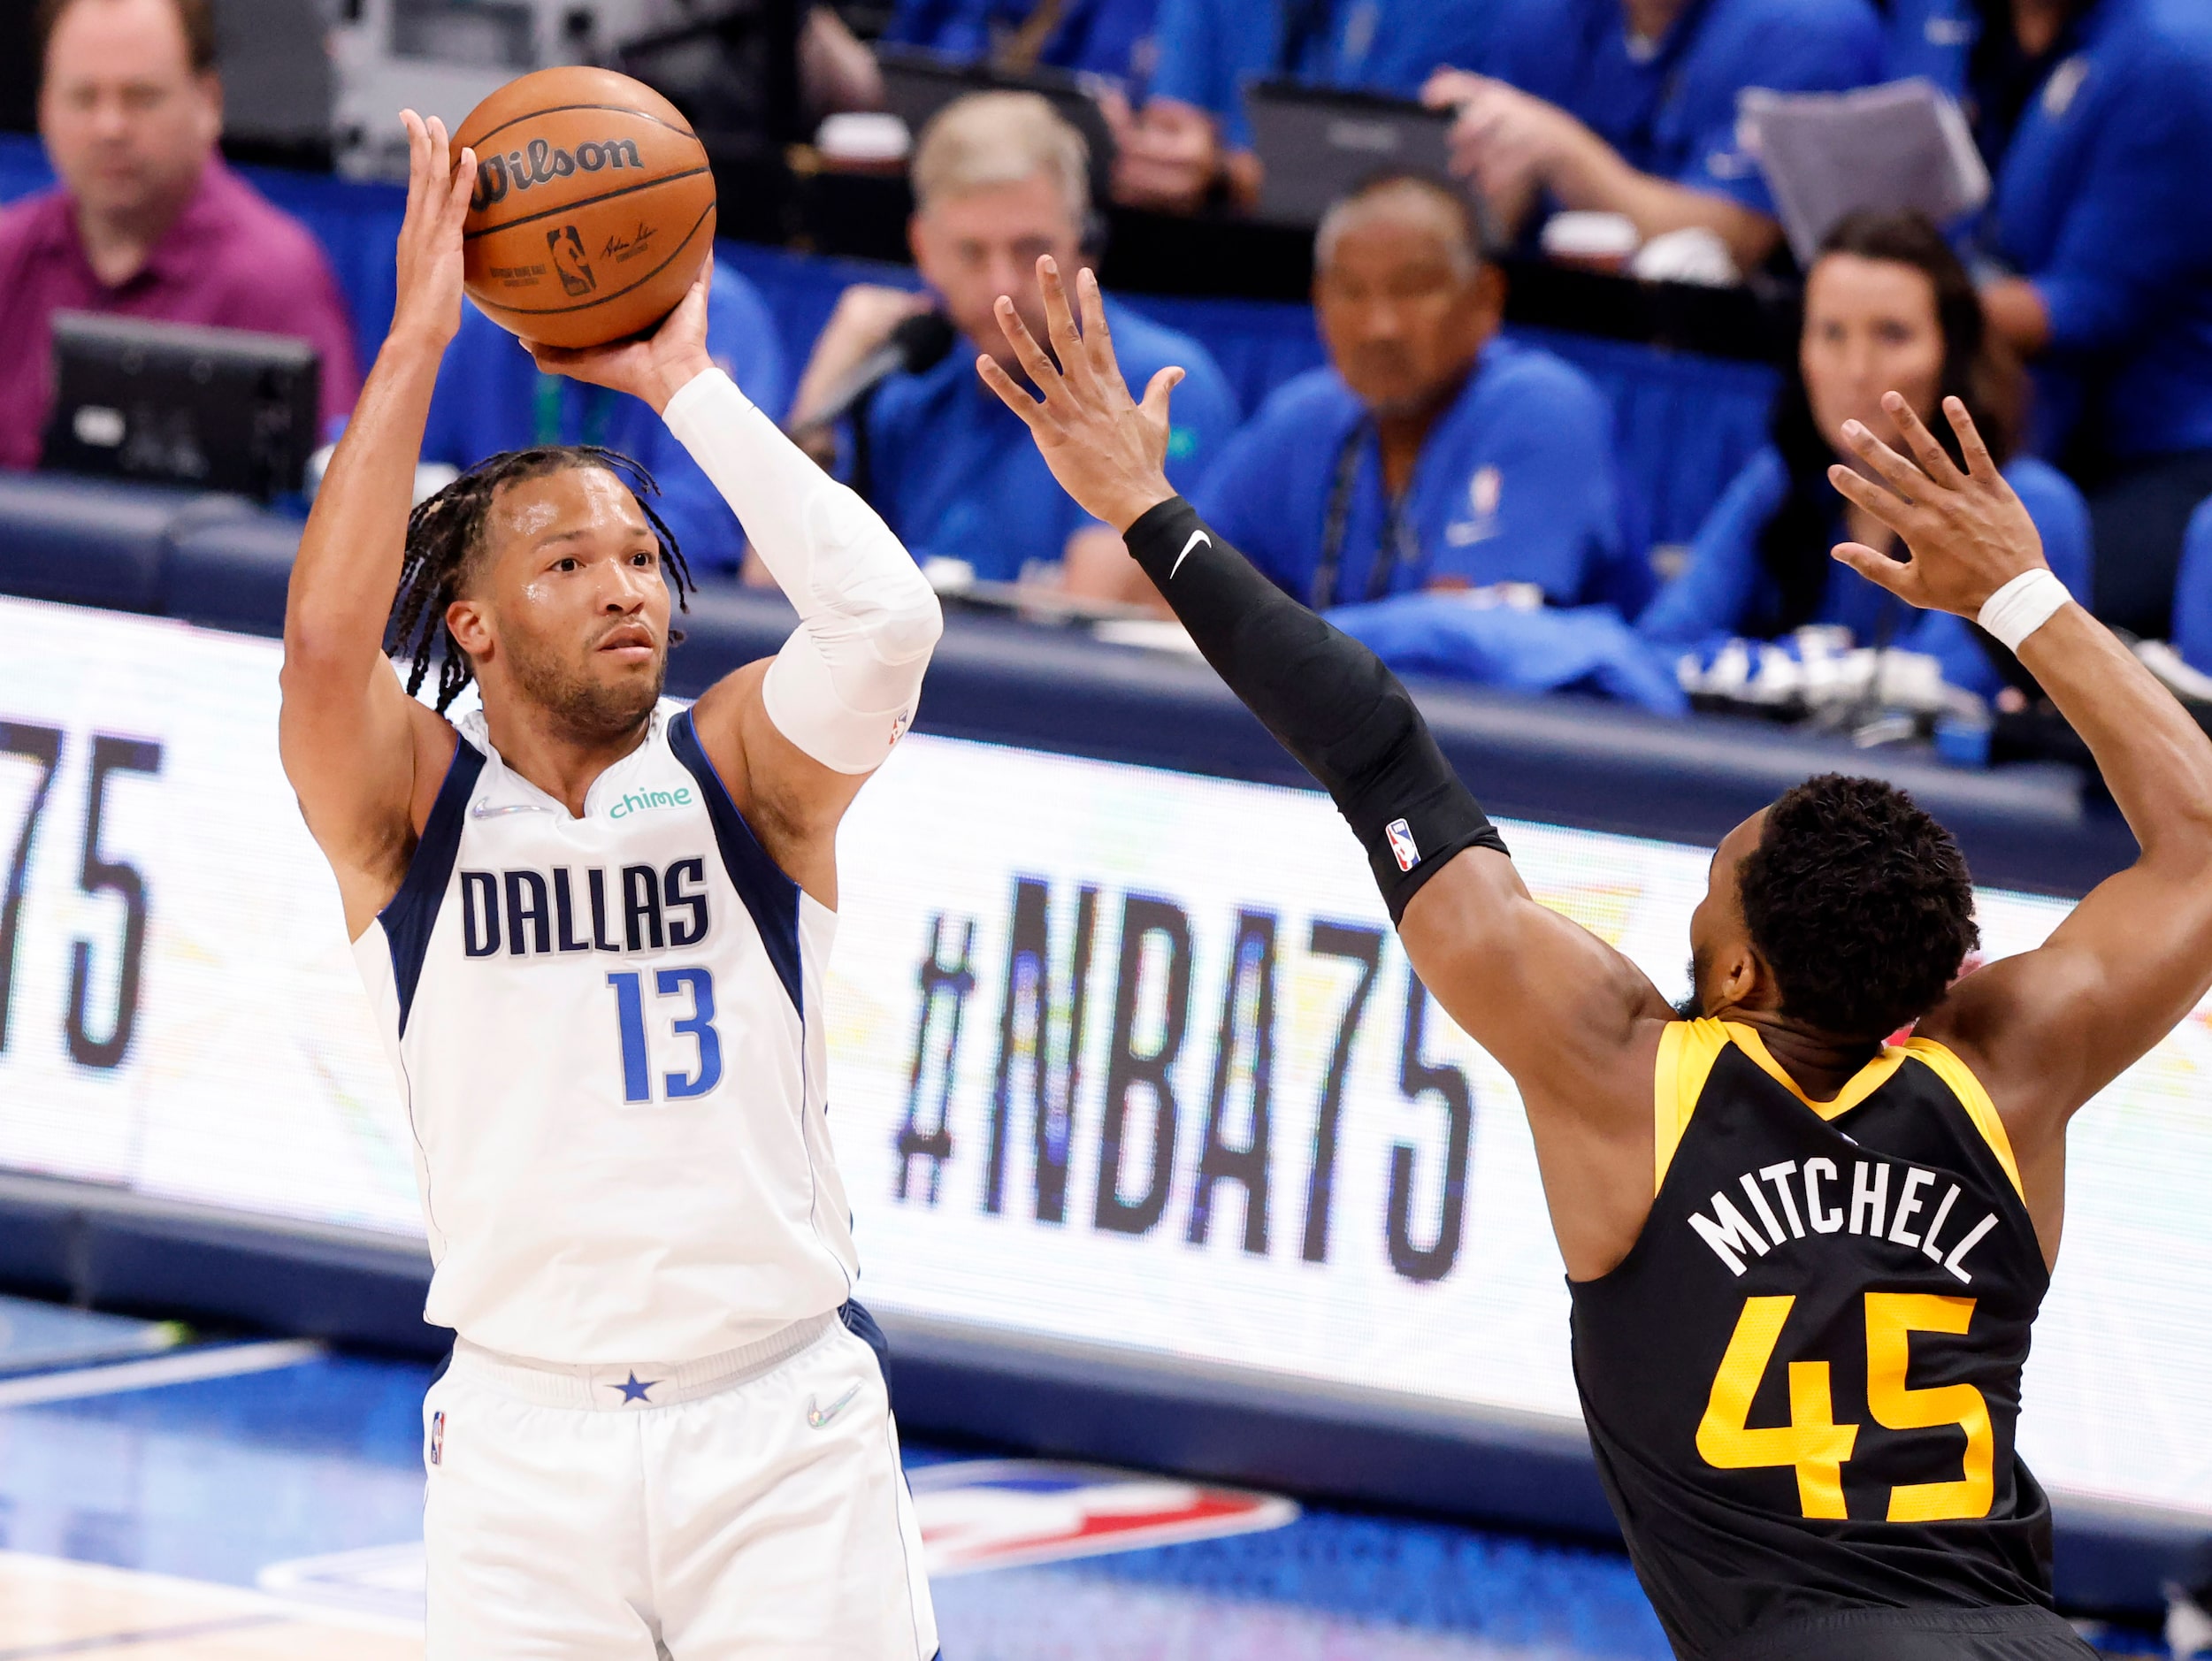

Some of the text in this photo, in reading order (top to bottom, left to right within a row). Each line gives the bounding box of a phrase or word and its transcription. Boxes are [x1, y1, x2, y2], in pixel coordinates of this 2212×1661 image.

[471, 138, 645, 211] Wilson
[609, 787, 693, 819] chime
[460, 855, 710, 960] DALLAS
[605, 966, 723, 1105] 13
[895, 874, 1473, 1282] #NBA75
[1688, 1157, 1999, 1284] MITCHELL
[1695, 1292, 1994, 1522] 45
